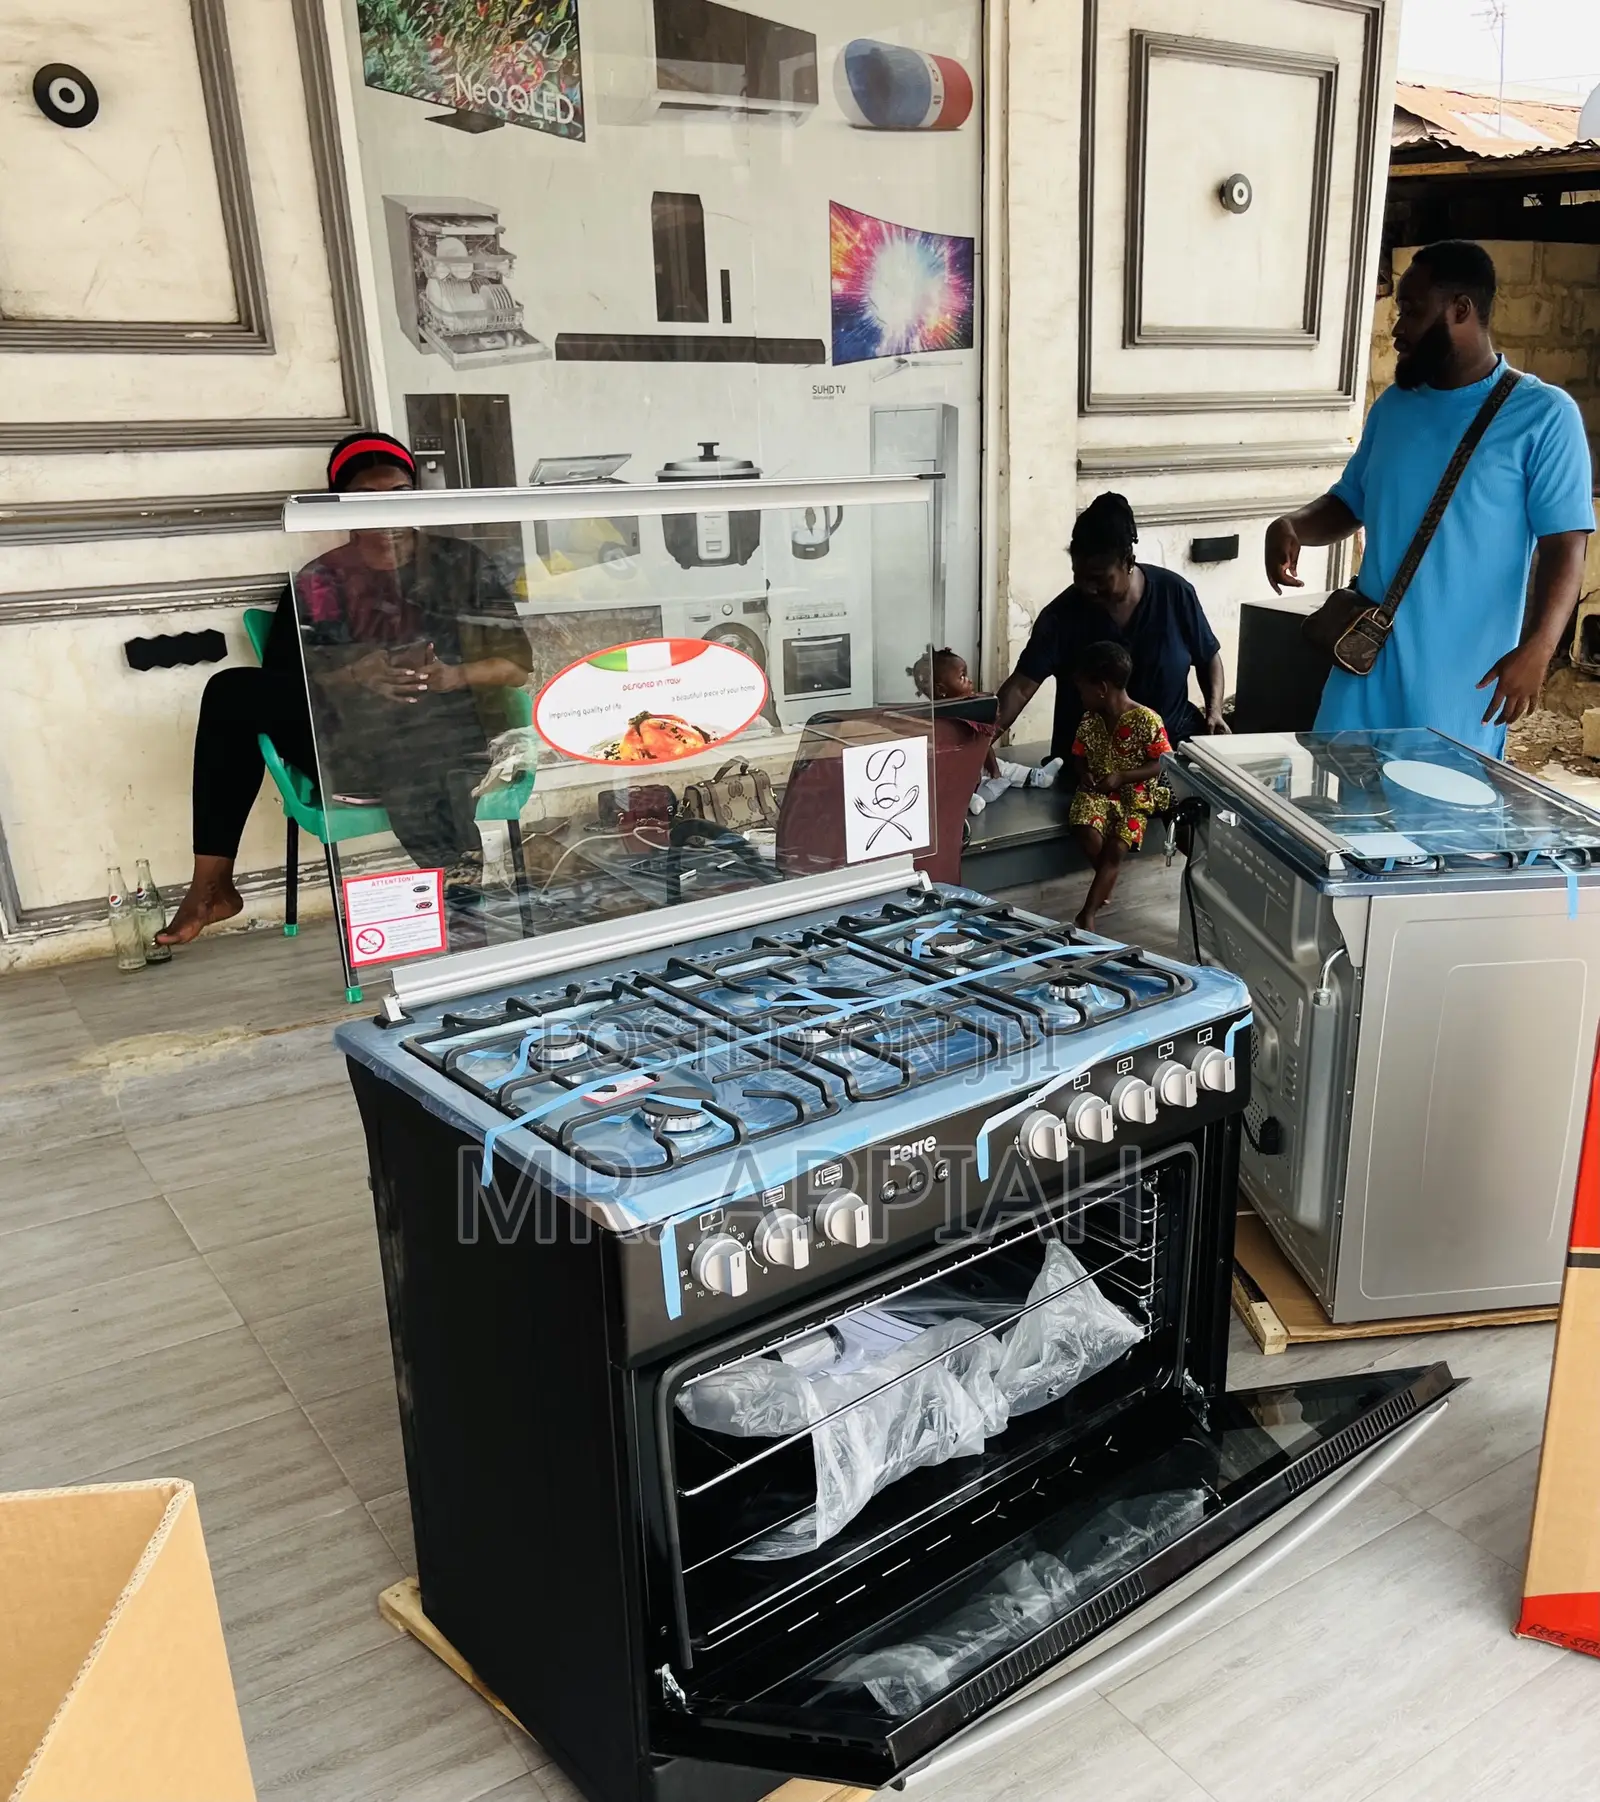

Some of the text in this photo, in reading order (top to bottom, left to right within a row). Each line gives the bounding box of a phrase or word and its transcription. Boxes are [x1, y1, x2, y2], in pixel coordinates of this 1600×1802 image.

[455, 73, 575, 124] Neo QLED
[812, 385, 846, 394] SUHD TV
[740, 684, 756, 692] home
[583, 705, 603, 715] quality
[889, 1135, 937, 1166] Ferre
[729, 1225, 737, 1233] 10
[737, 1232, 745, 1240] 20
[1527, 1623, 1569, 1641] FREE
